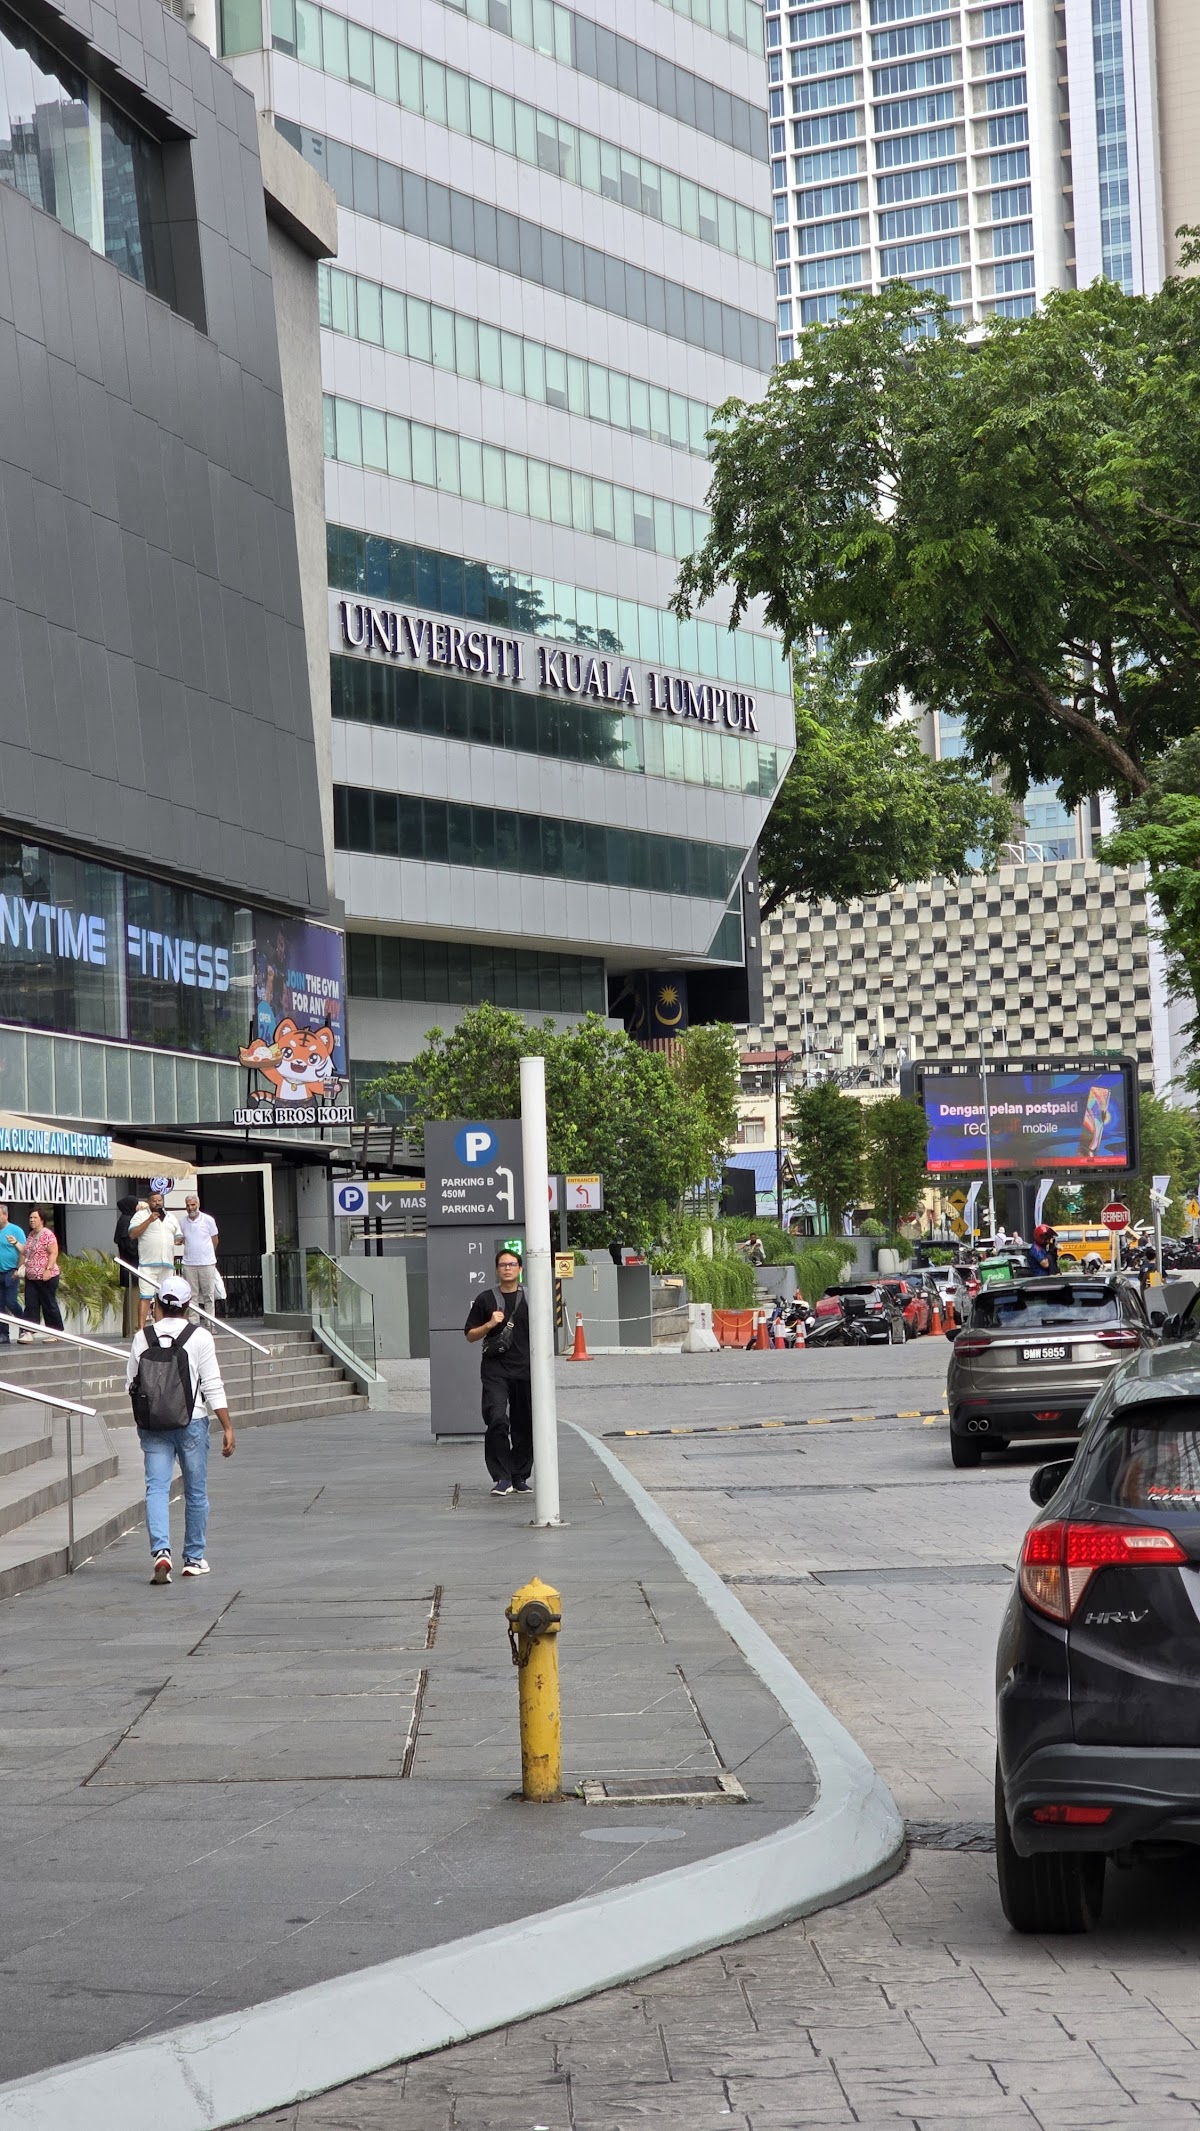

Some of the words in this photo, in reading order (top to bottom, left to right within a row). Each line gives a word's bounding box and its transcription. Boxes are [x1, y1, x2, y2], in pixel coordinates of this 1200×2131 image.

[339, 600, 525, 680] UNIVERSITI
[538, 646, 639, 706] KUALA
[649, 672, 759, 732] LUMPUR
[128, 924, 230, 992] FITNESS
[286, 969, 305, 991] JOIN
[306, 974, 322, 995] THE
[322, 979, 339, 999] GYM
[292, 992, 308, 1012] FOR
[234, 1109, 273, 1125] LUCK
[276, 1107, 316, 1124] BROS
[318, 1106, 354, 1122] KOPI
[940, 1104, 985, 1118] Dengan
[990, 1102, 1023, 1117] pelan
[1025, 1101, 1078, 1117] postpaid
[1022, 1122, 1058, 1134] mobile
[10, 1129, 49, 1153] CUISINE
[50, 1132, 69, 1155] AND
[71, 1134, 112, 1159] HERITAGE
[466, 1132, 491, 1161] P
[15, 1172, 64, 1203] NYONYA
[65, 1176, 107, 1205] MODEN
[441, 1178, 484, 1186] PARKING
[487, 1177, 494, 1185] B
[344, 1190, 359, 1208] P
[441, 1190, 466, 1198] 450M
[442, 1205, 485, 1213] PARKING
[487, 1204, 494, 1212] A
[468, 1243, 483, 1254] P1
[469, 1272, 485, 1283] P2
[1042, 1346, 1065, 1358] 5855
[1084, 1609, 1149, 1624] HR-V
